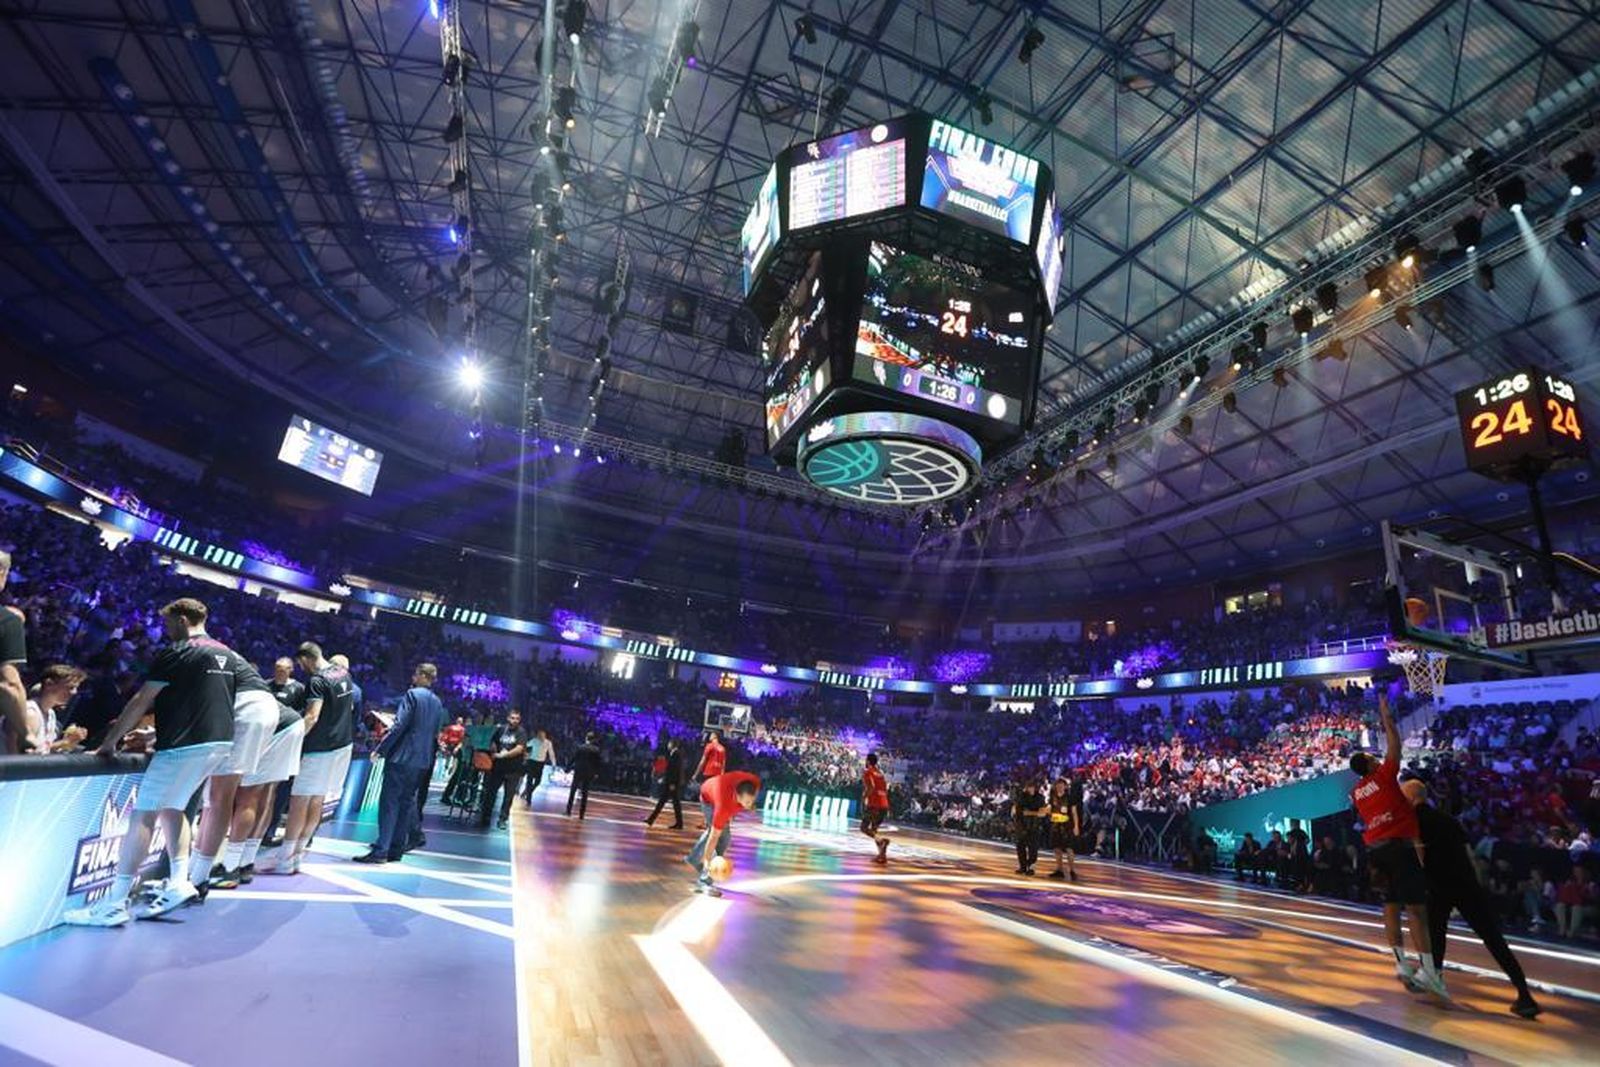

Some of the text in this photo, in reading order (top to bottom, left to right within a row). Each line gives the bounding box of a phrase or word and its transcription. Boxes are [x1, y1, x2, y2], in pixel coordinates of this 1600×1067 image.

[928, 119, 986, 165] FINAL
[941, 312, 968, 338] 24
[903, 373, 912, 387] 0
[929, 381, 957, 401] 1:26
[1474, 373, 1530, 406] 1:26
[966, 392, 975, 404] 0
[1471, 399, 1533, 448] 24
[1547, 399, 1582, 440] 24
[153, 527, 245, 570] FINAL FOUR
[406, 599, 487, 625] FINAL FOUR
[1495, 609, 1600, 644] #Basketb
[626, 640, 696, 662] FINAL FOUR
[819, 671, 884, 690] FINAL FOUR
[1200, 662, 1282, 685] FINAL FOUR
[1011, 682, 1075, 697] FINAL FOUR
[763, 790, 850, 821] FINAL FOUR
[77, 838, 121, 876] FINA
